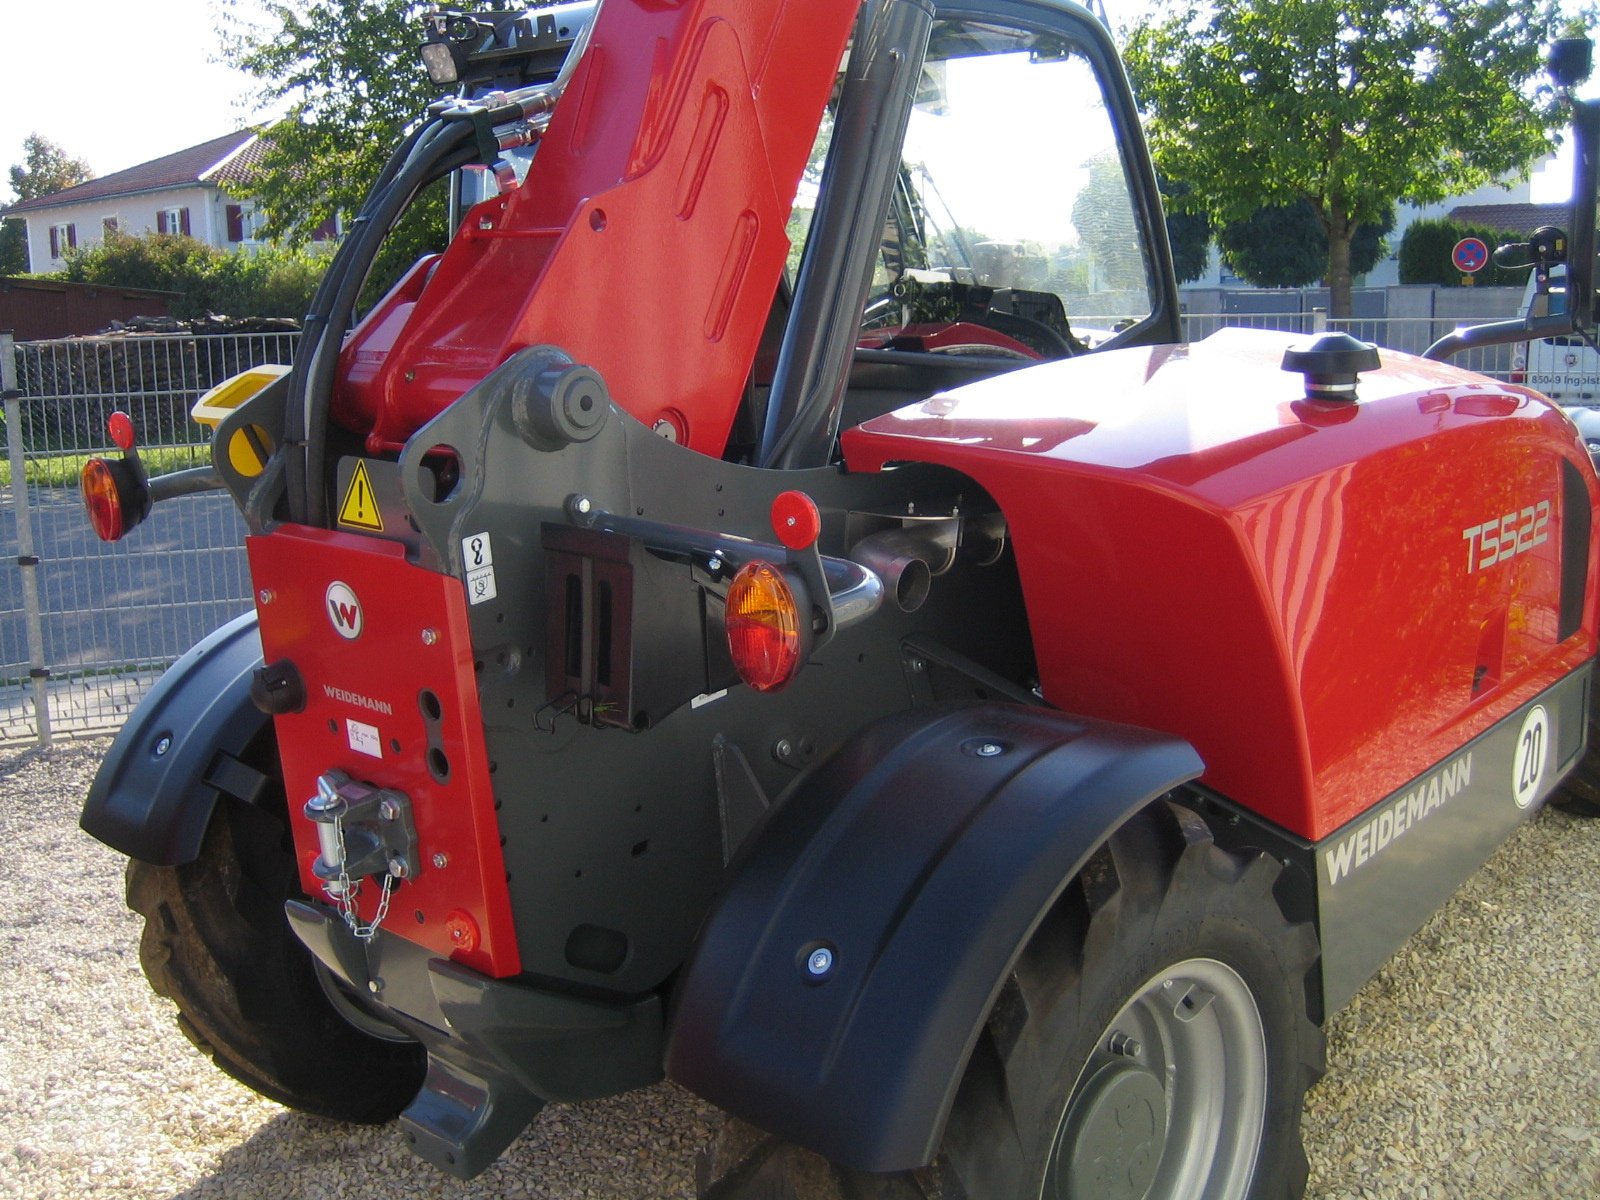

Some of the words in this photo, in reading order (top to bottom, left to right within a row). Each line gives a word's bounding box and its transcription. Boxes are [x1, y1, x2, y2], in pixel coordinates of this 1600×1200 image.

[1463, 500, 1550, 574] T5522
[323, 684, 392, 716] WEIDEMANN
[1519, 721, 1541, 794] 20
[1325, 752, 1472, 886] WEIDEMANN
